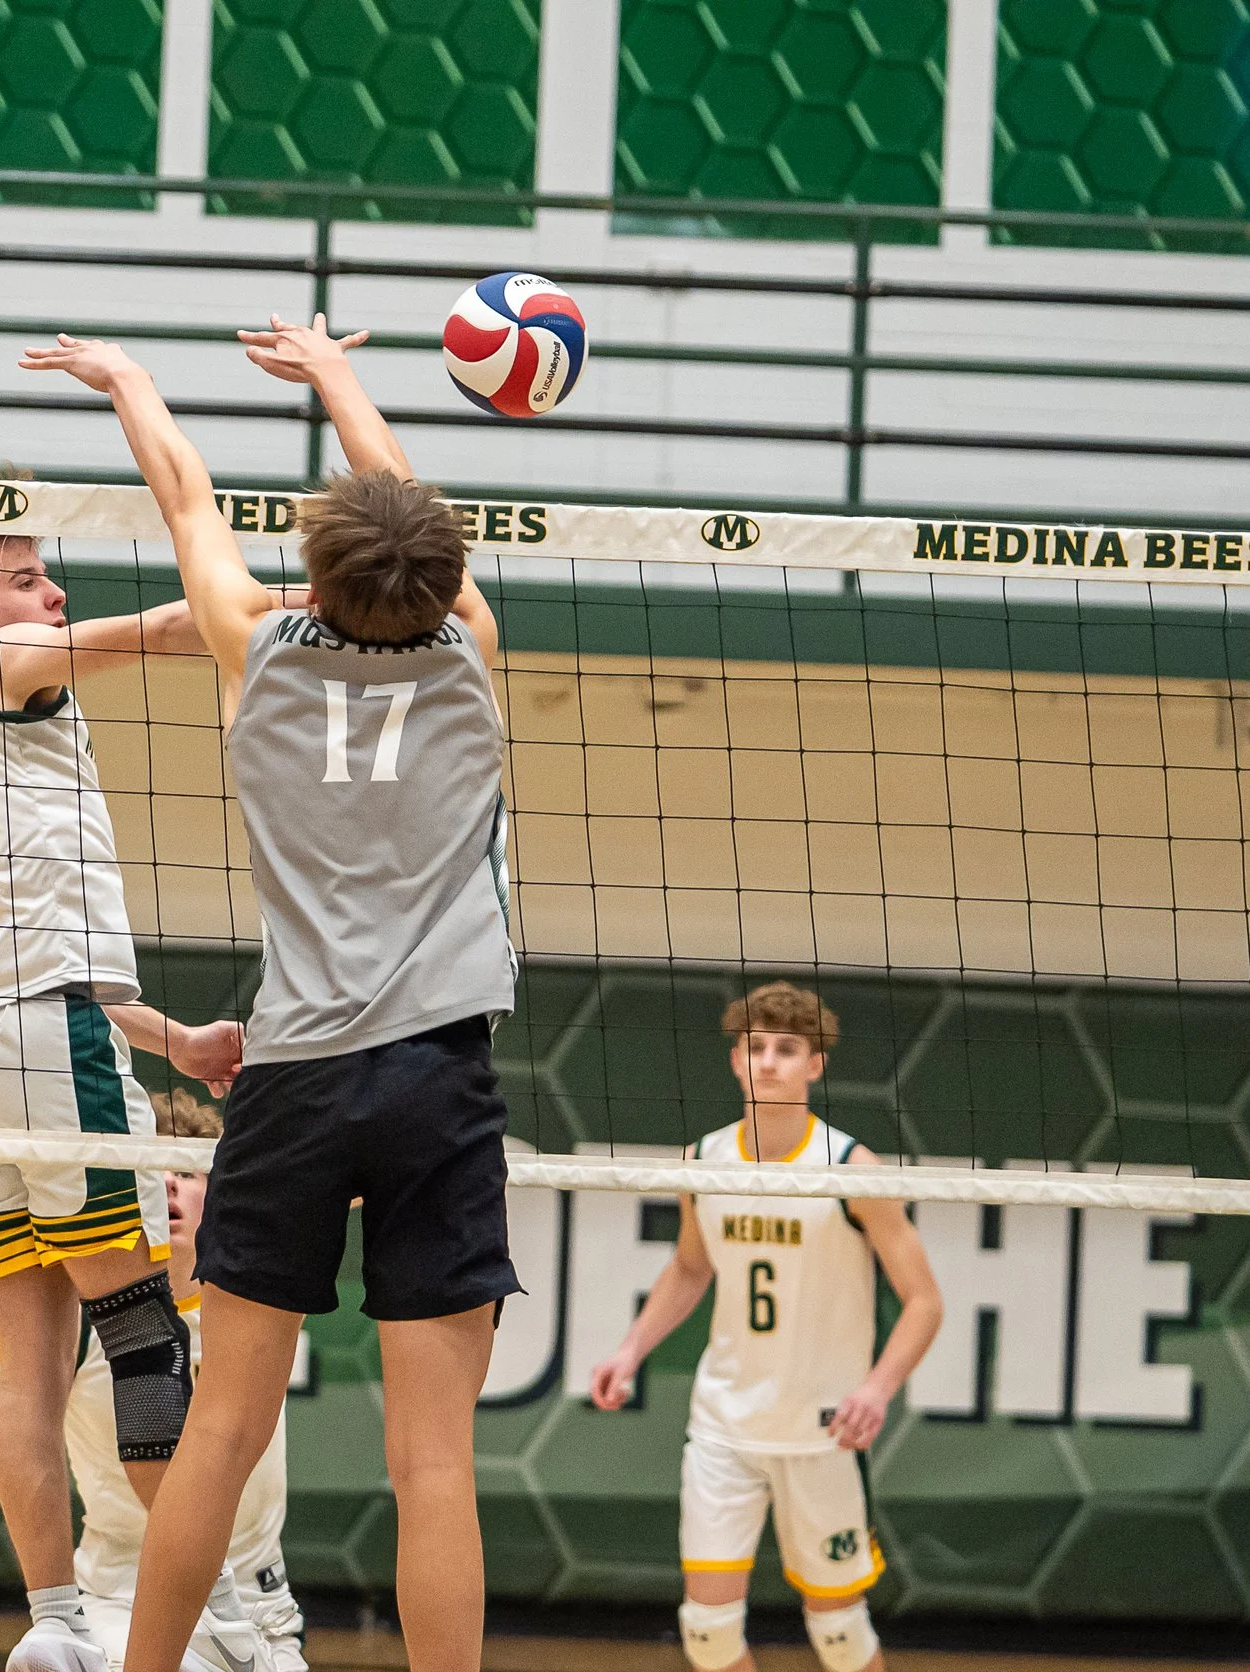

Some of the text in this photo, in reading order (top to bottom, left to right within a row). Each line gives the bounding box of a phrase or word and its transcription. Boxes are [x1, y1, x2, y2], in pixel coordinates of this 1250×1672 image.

[709, 515, 753, 550] M
[913, 523, 1250, 573] MEDINA BEE
[321, 679, 418, 783] 17
[723, 1215, 802, 1246] MEDINA
[750, 1258, 776, 1333] 6
[877, 1153, 1195, 1425] HE
